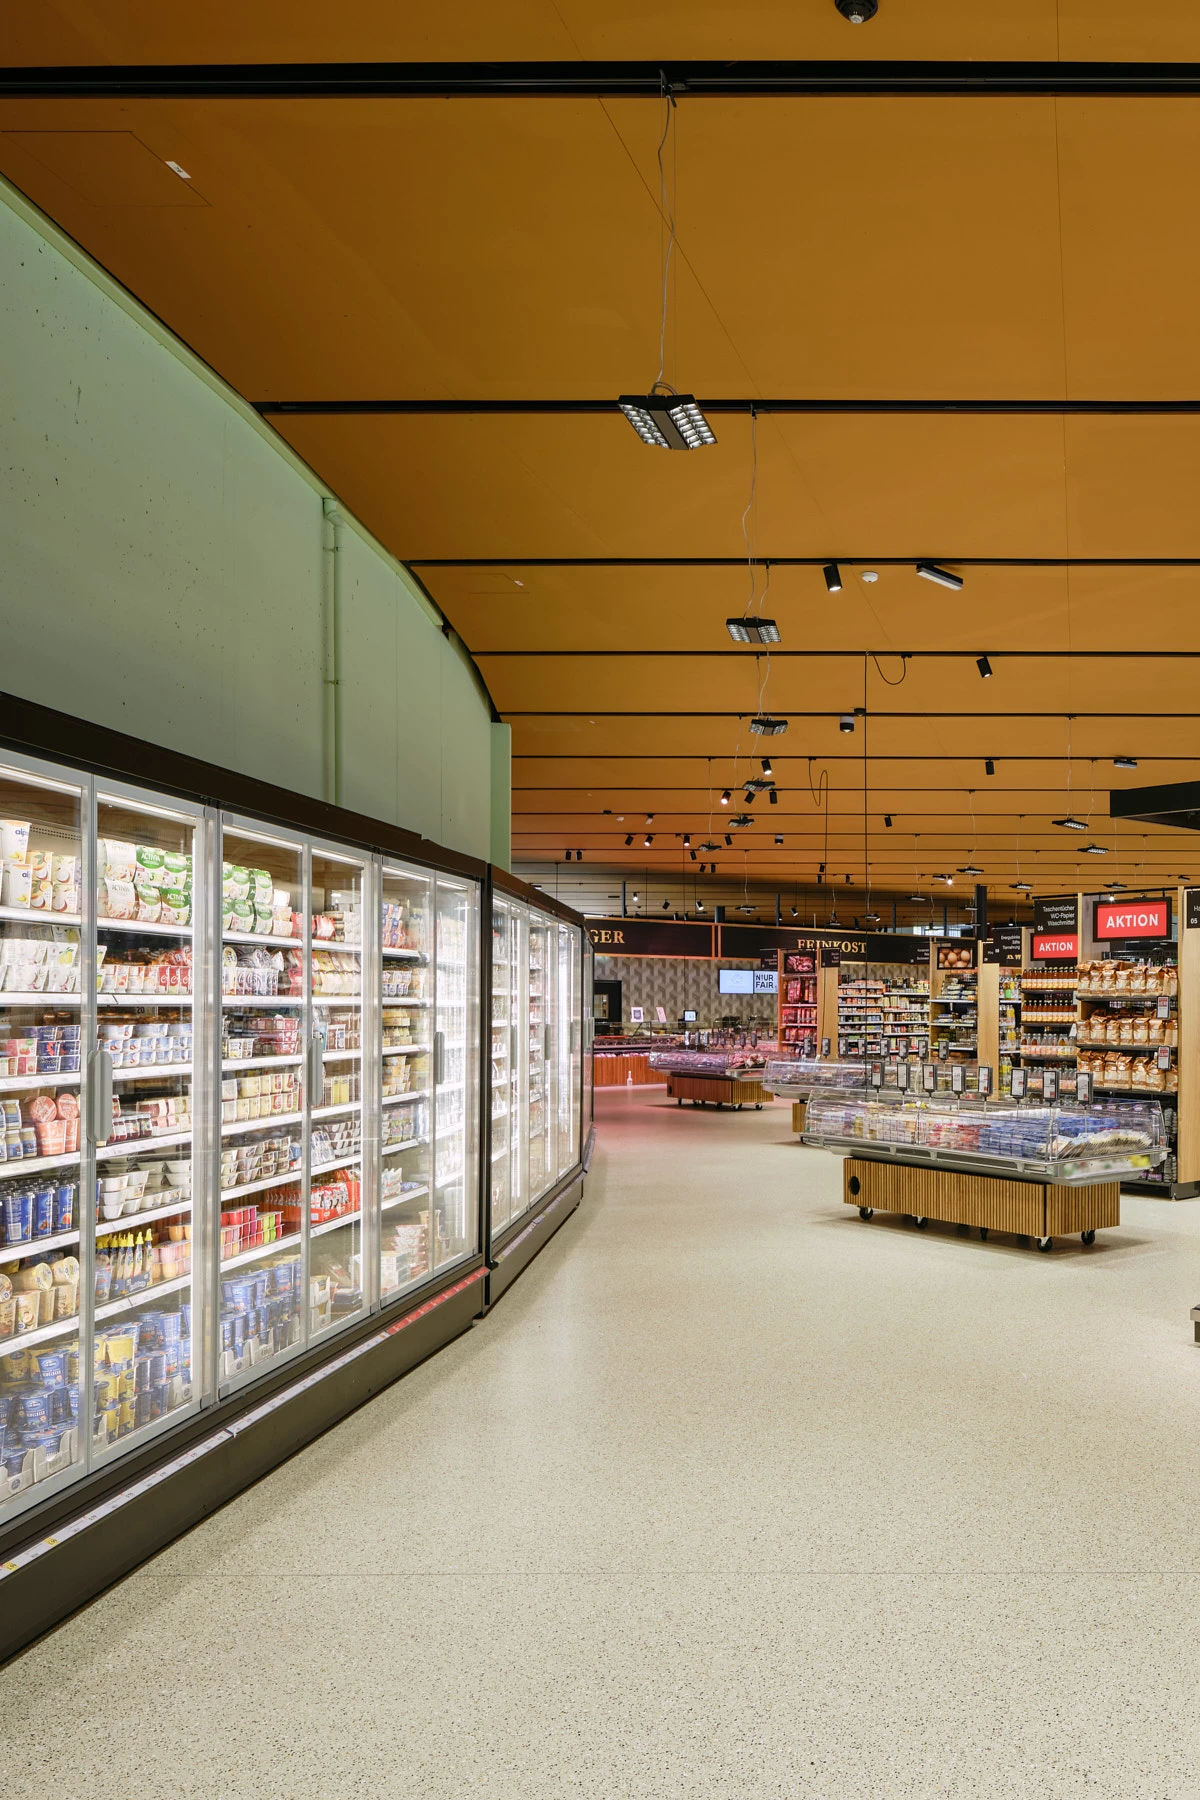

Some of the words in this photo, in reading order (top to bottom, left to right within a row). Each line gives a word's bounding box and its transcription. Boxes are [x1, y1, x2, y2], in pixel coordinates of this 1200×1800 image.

[1106, 914, 1159, 928] AKTION
[797, 939, 866, 954] FEINKOST
[1039, 942, 1073, 952] AKTION
